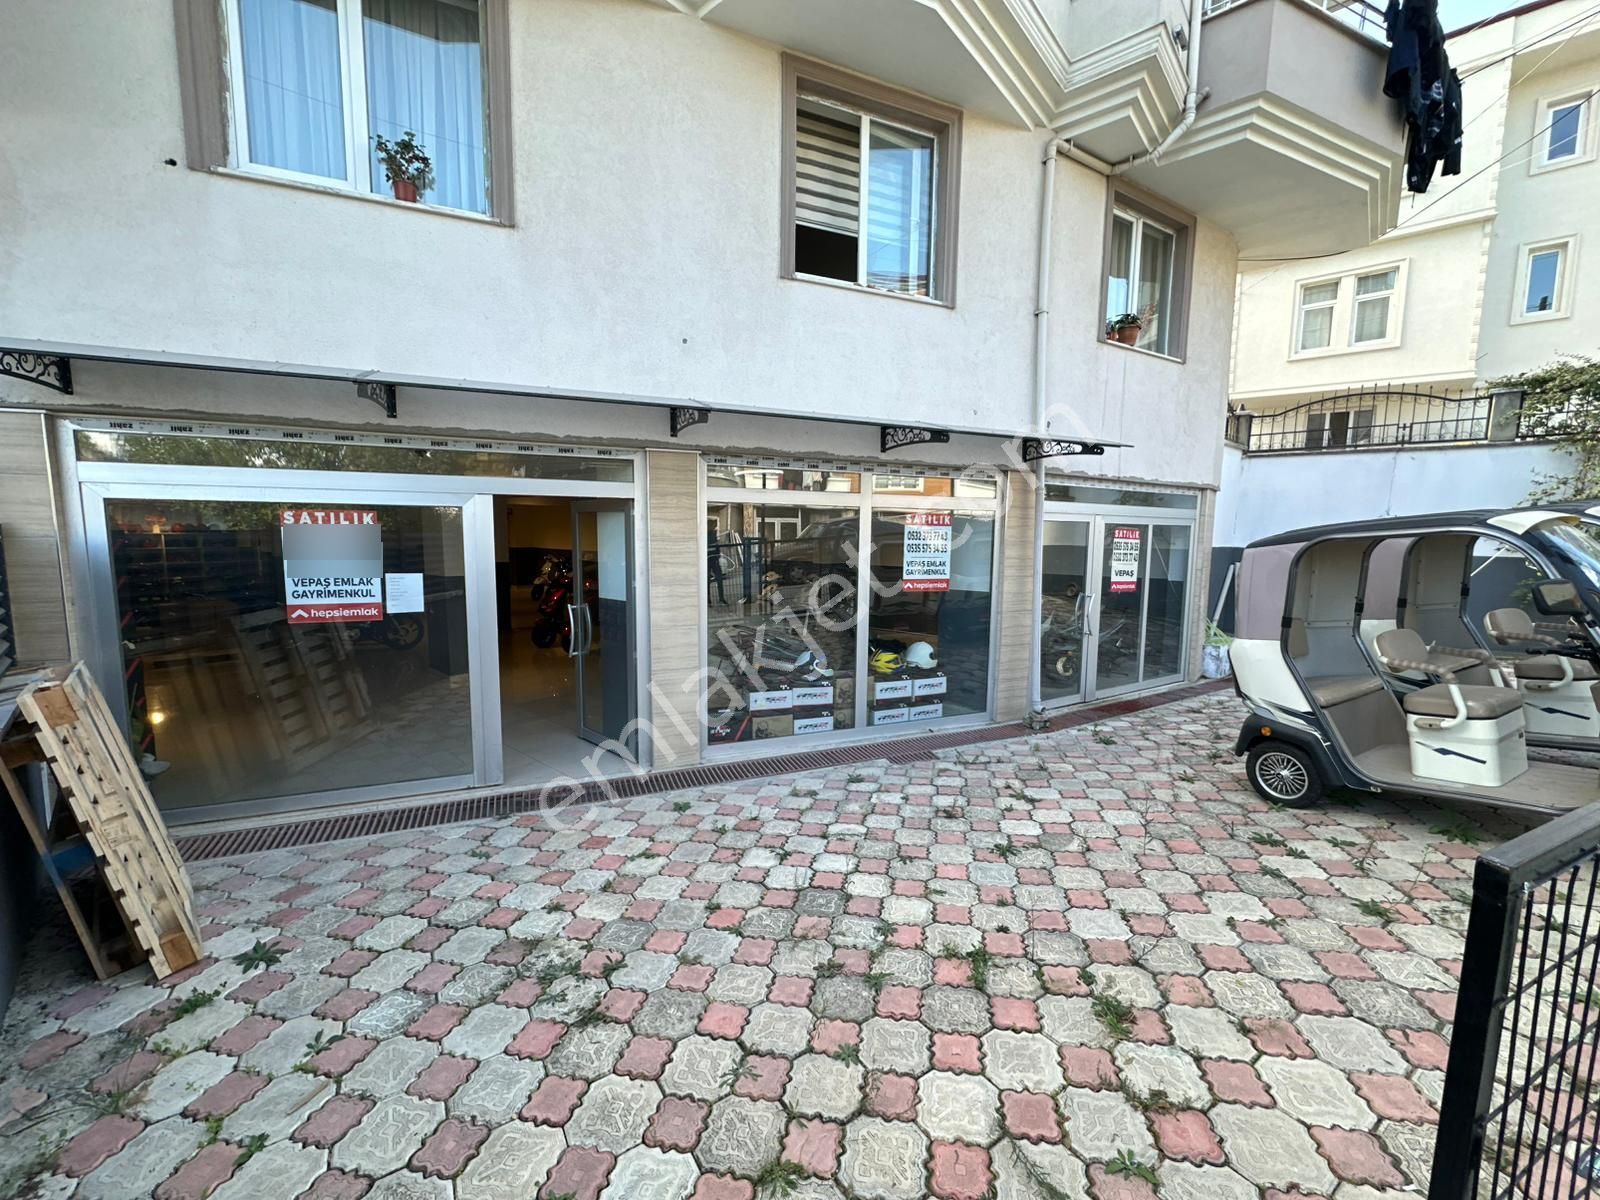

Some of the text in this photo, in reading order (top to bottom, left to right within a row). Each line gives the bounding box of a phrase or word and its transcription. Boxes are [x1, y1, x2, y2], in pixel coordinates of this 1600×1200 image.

[283, 511, 375, 525] SATILIK
[905, 514, 951, 525] SATILIK
[1114, 569, 1134, 578] VEPAŞ
[292, 577, 374, 588] VEPAŞ EMLAK
[291, 587, 376, 599] GAYRİMENKUL
[310, 607, 378, 618] hepsiemlak
